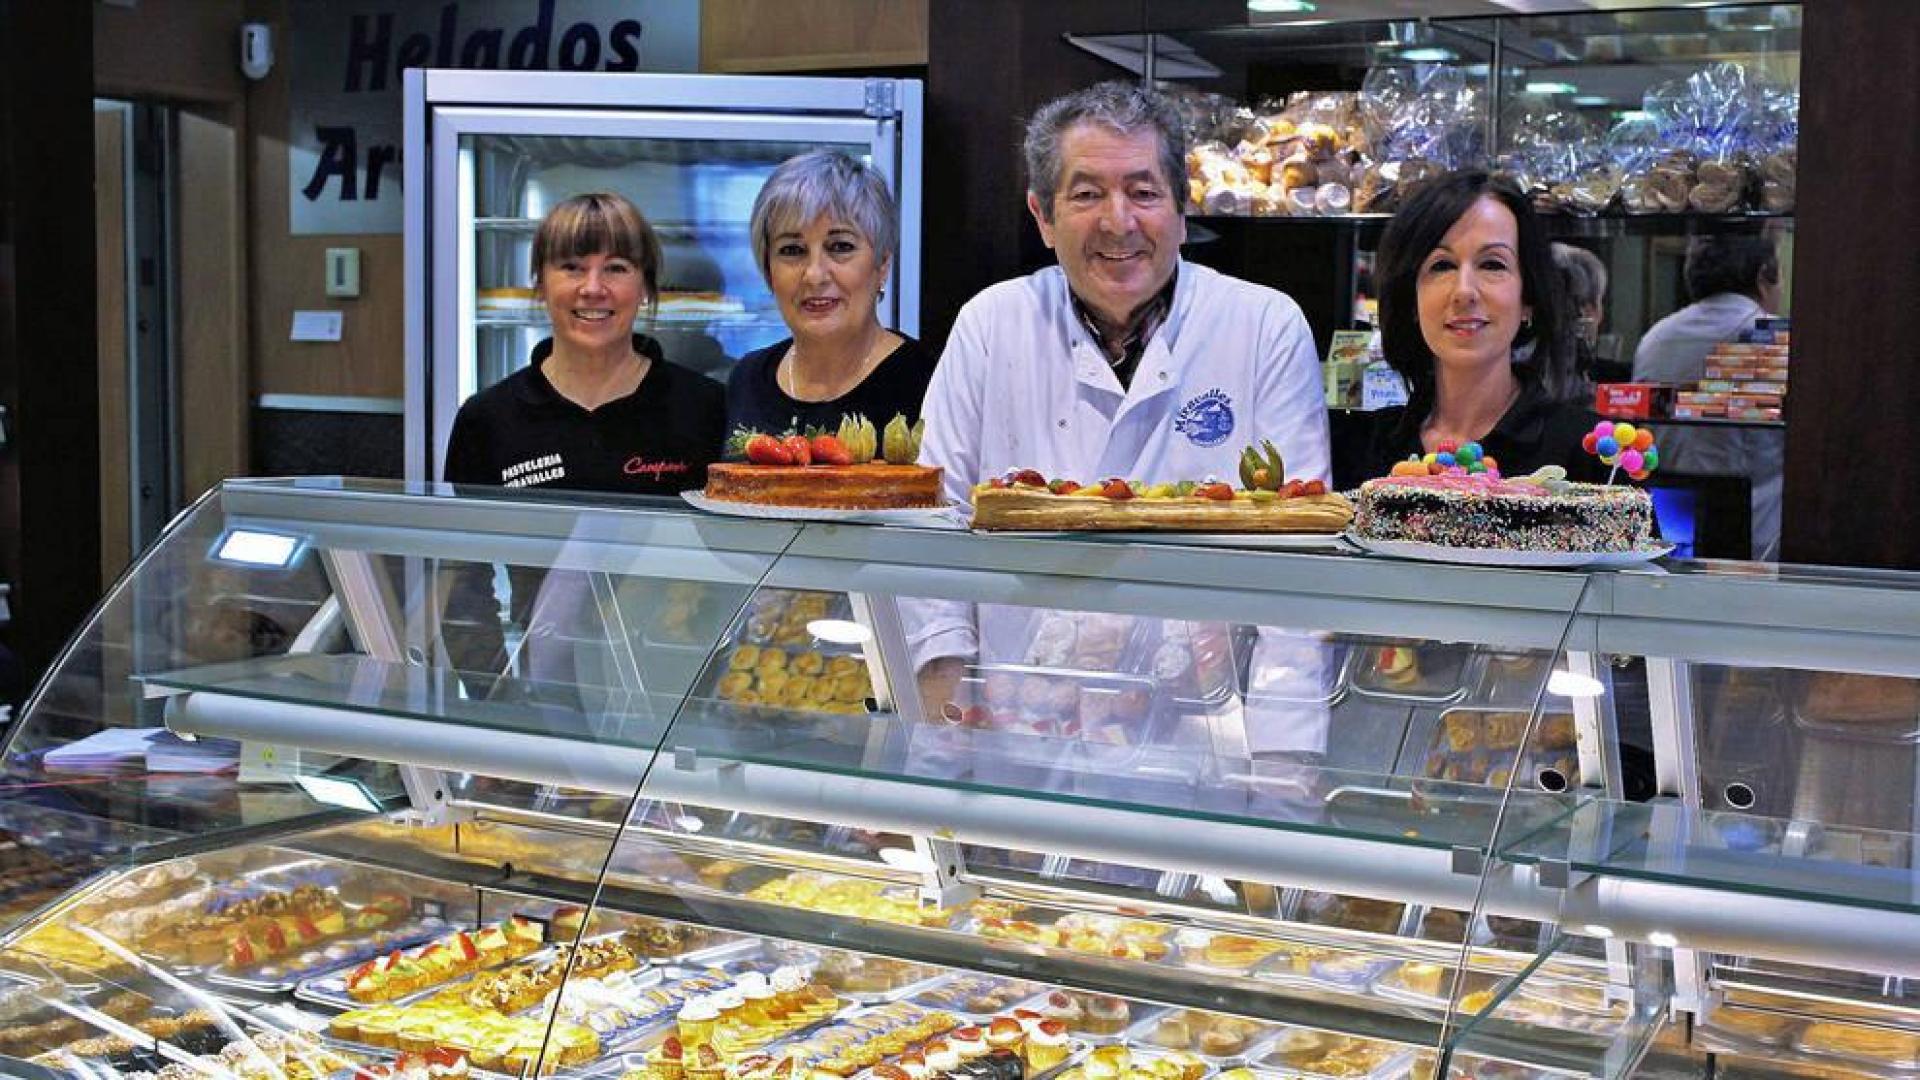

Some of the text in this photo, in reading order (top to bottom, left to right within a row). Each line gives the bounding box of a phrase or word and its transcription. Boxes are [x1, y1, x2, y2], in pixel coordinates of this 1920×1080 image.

[344, 0, 642, 93] Helados
[302, 127, 404, 201] Ar
[1174, 387, 1232, 433] Miravalles
[502, 453, 562, 482] PASTELERIA
[504, 466, 565, 488] RAVALLES
